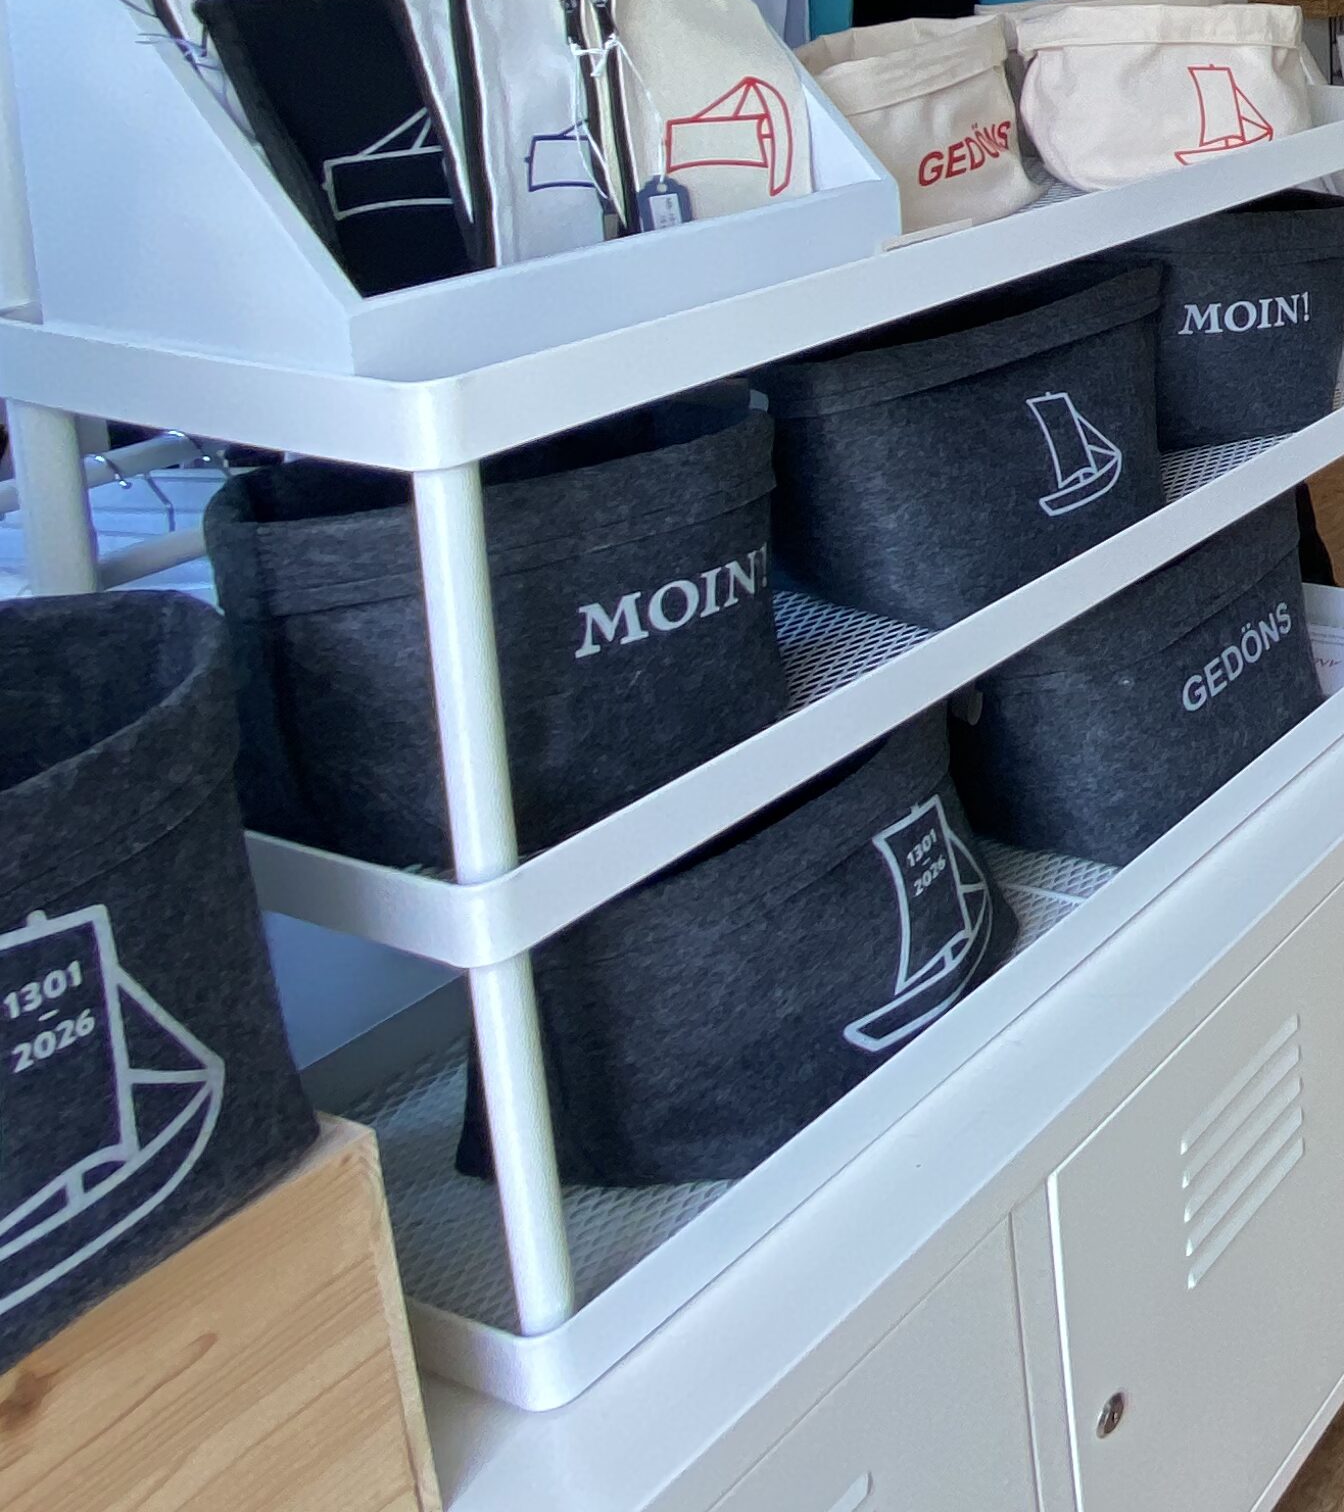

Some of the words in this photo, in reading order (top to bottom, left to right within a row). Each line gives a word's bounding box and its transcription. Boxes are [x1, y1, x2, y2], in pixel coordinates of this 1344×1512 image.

[917, 121, 1012, 187] GEDÖNS
[1178, 291, 1310, 336] MOIN!
[575, 542, 770, 659] MOIN!
[1180, 602, 1293, 713] GEDÖNS
[905, 828, 938, 869] 1301
[914, 857, 947, 897] 2026
[3, 961, 84, 1020] 1301
[12, 1010, 96, 1073] 2026
